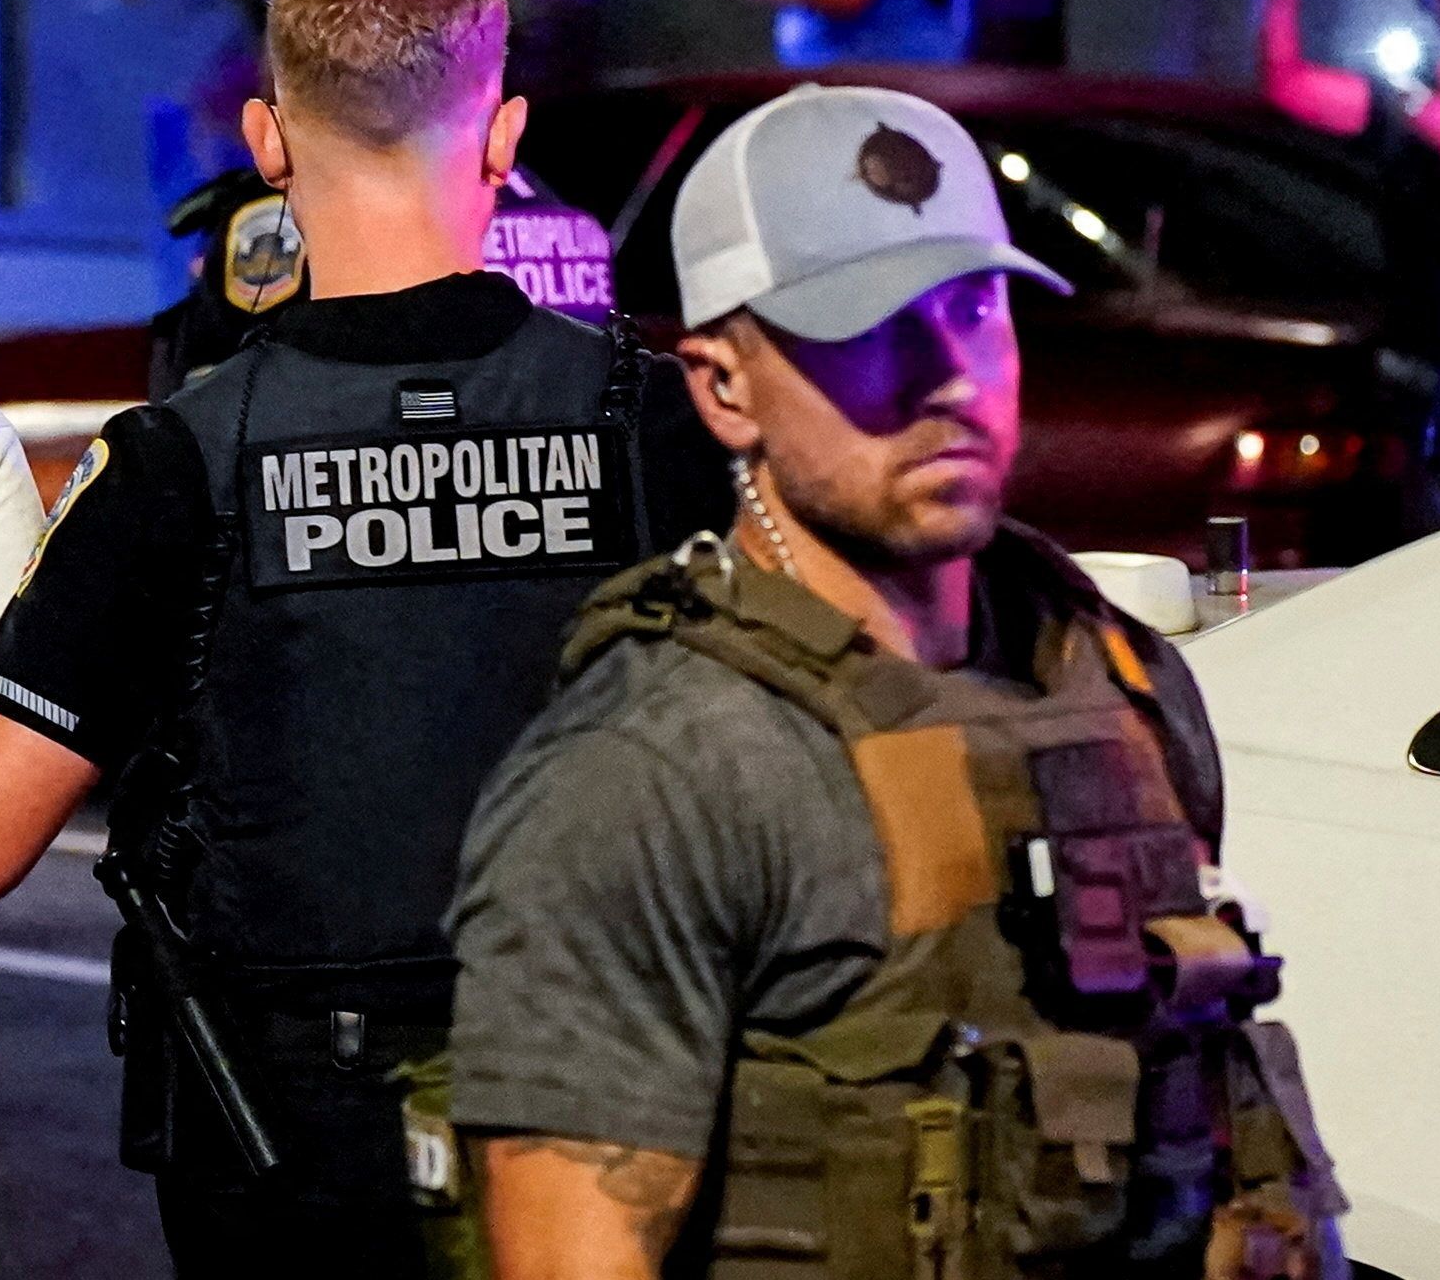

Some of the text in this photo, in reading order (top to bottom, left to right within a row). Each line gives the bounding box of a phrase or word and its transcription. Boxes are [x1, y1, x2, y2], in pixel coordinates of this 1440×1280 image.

[484, 262, 614, 306] OLICE
[261, 434, 602, 511] METROPOLITAN
[285, 496, 594, 571] POLICE
